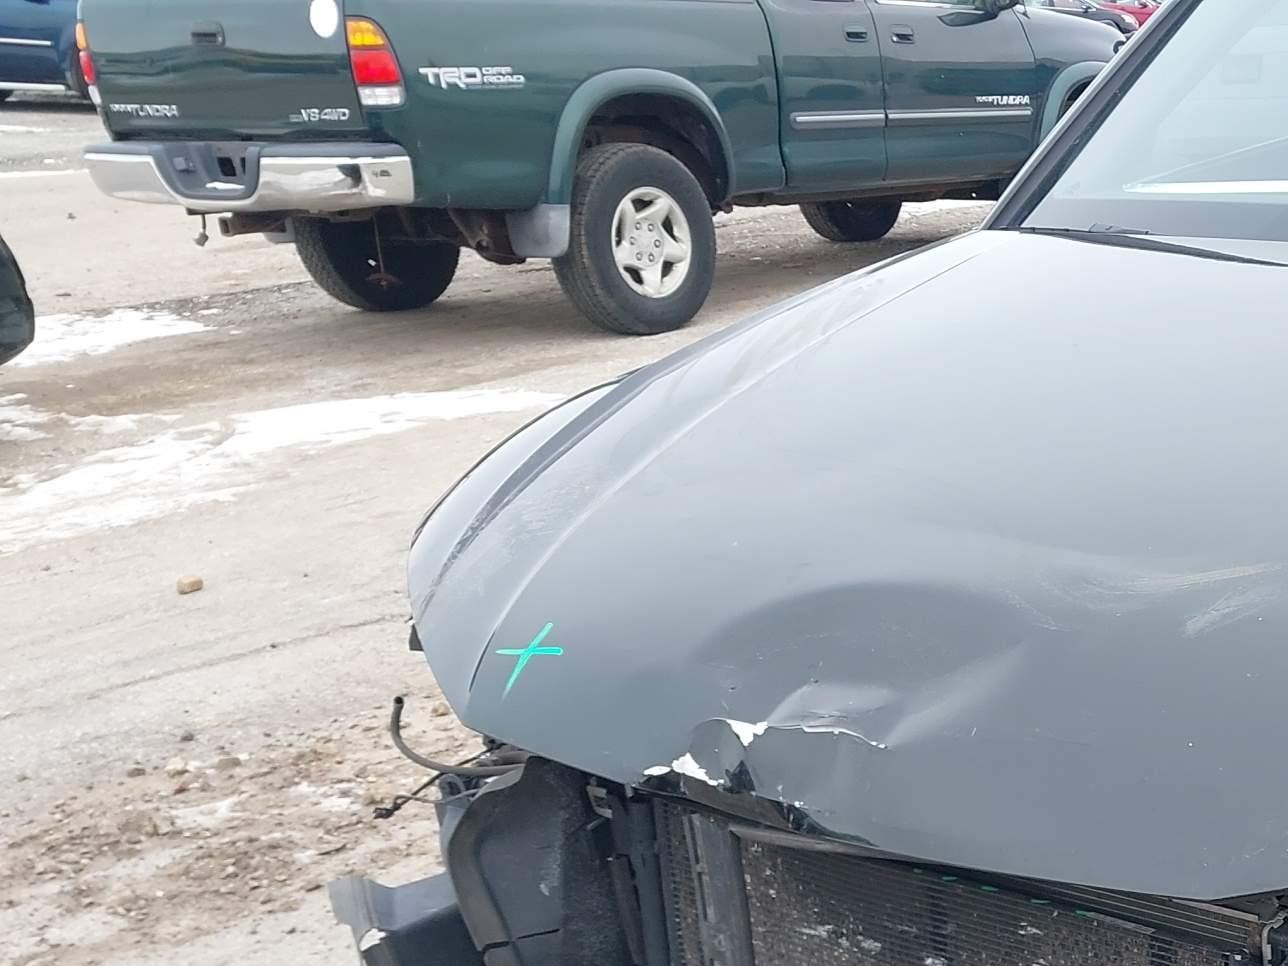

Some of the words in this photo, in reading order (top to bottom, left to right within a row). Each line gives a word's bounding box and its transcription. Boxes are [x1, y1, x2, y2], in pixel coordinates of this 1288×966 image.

[482, 66, 512, 75] OFF
[418, 67, 482, 90] TRD
[482, 75, 526, 84] ROAD
[993, 95, 1030, 105] TUNDRA
[131, 104, 178, 118] TUNDRA
